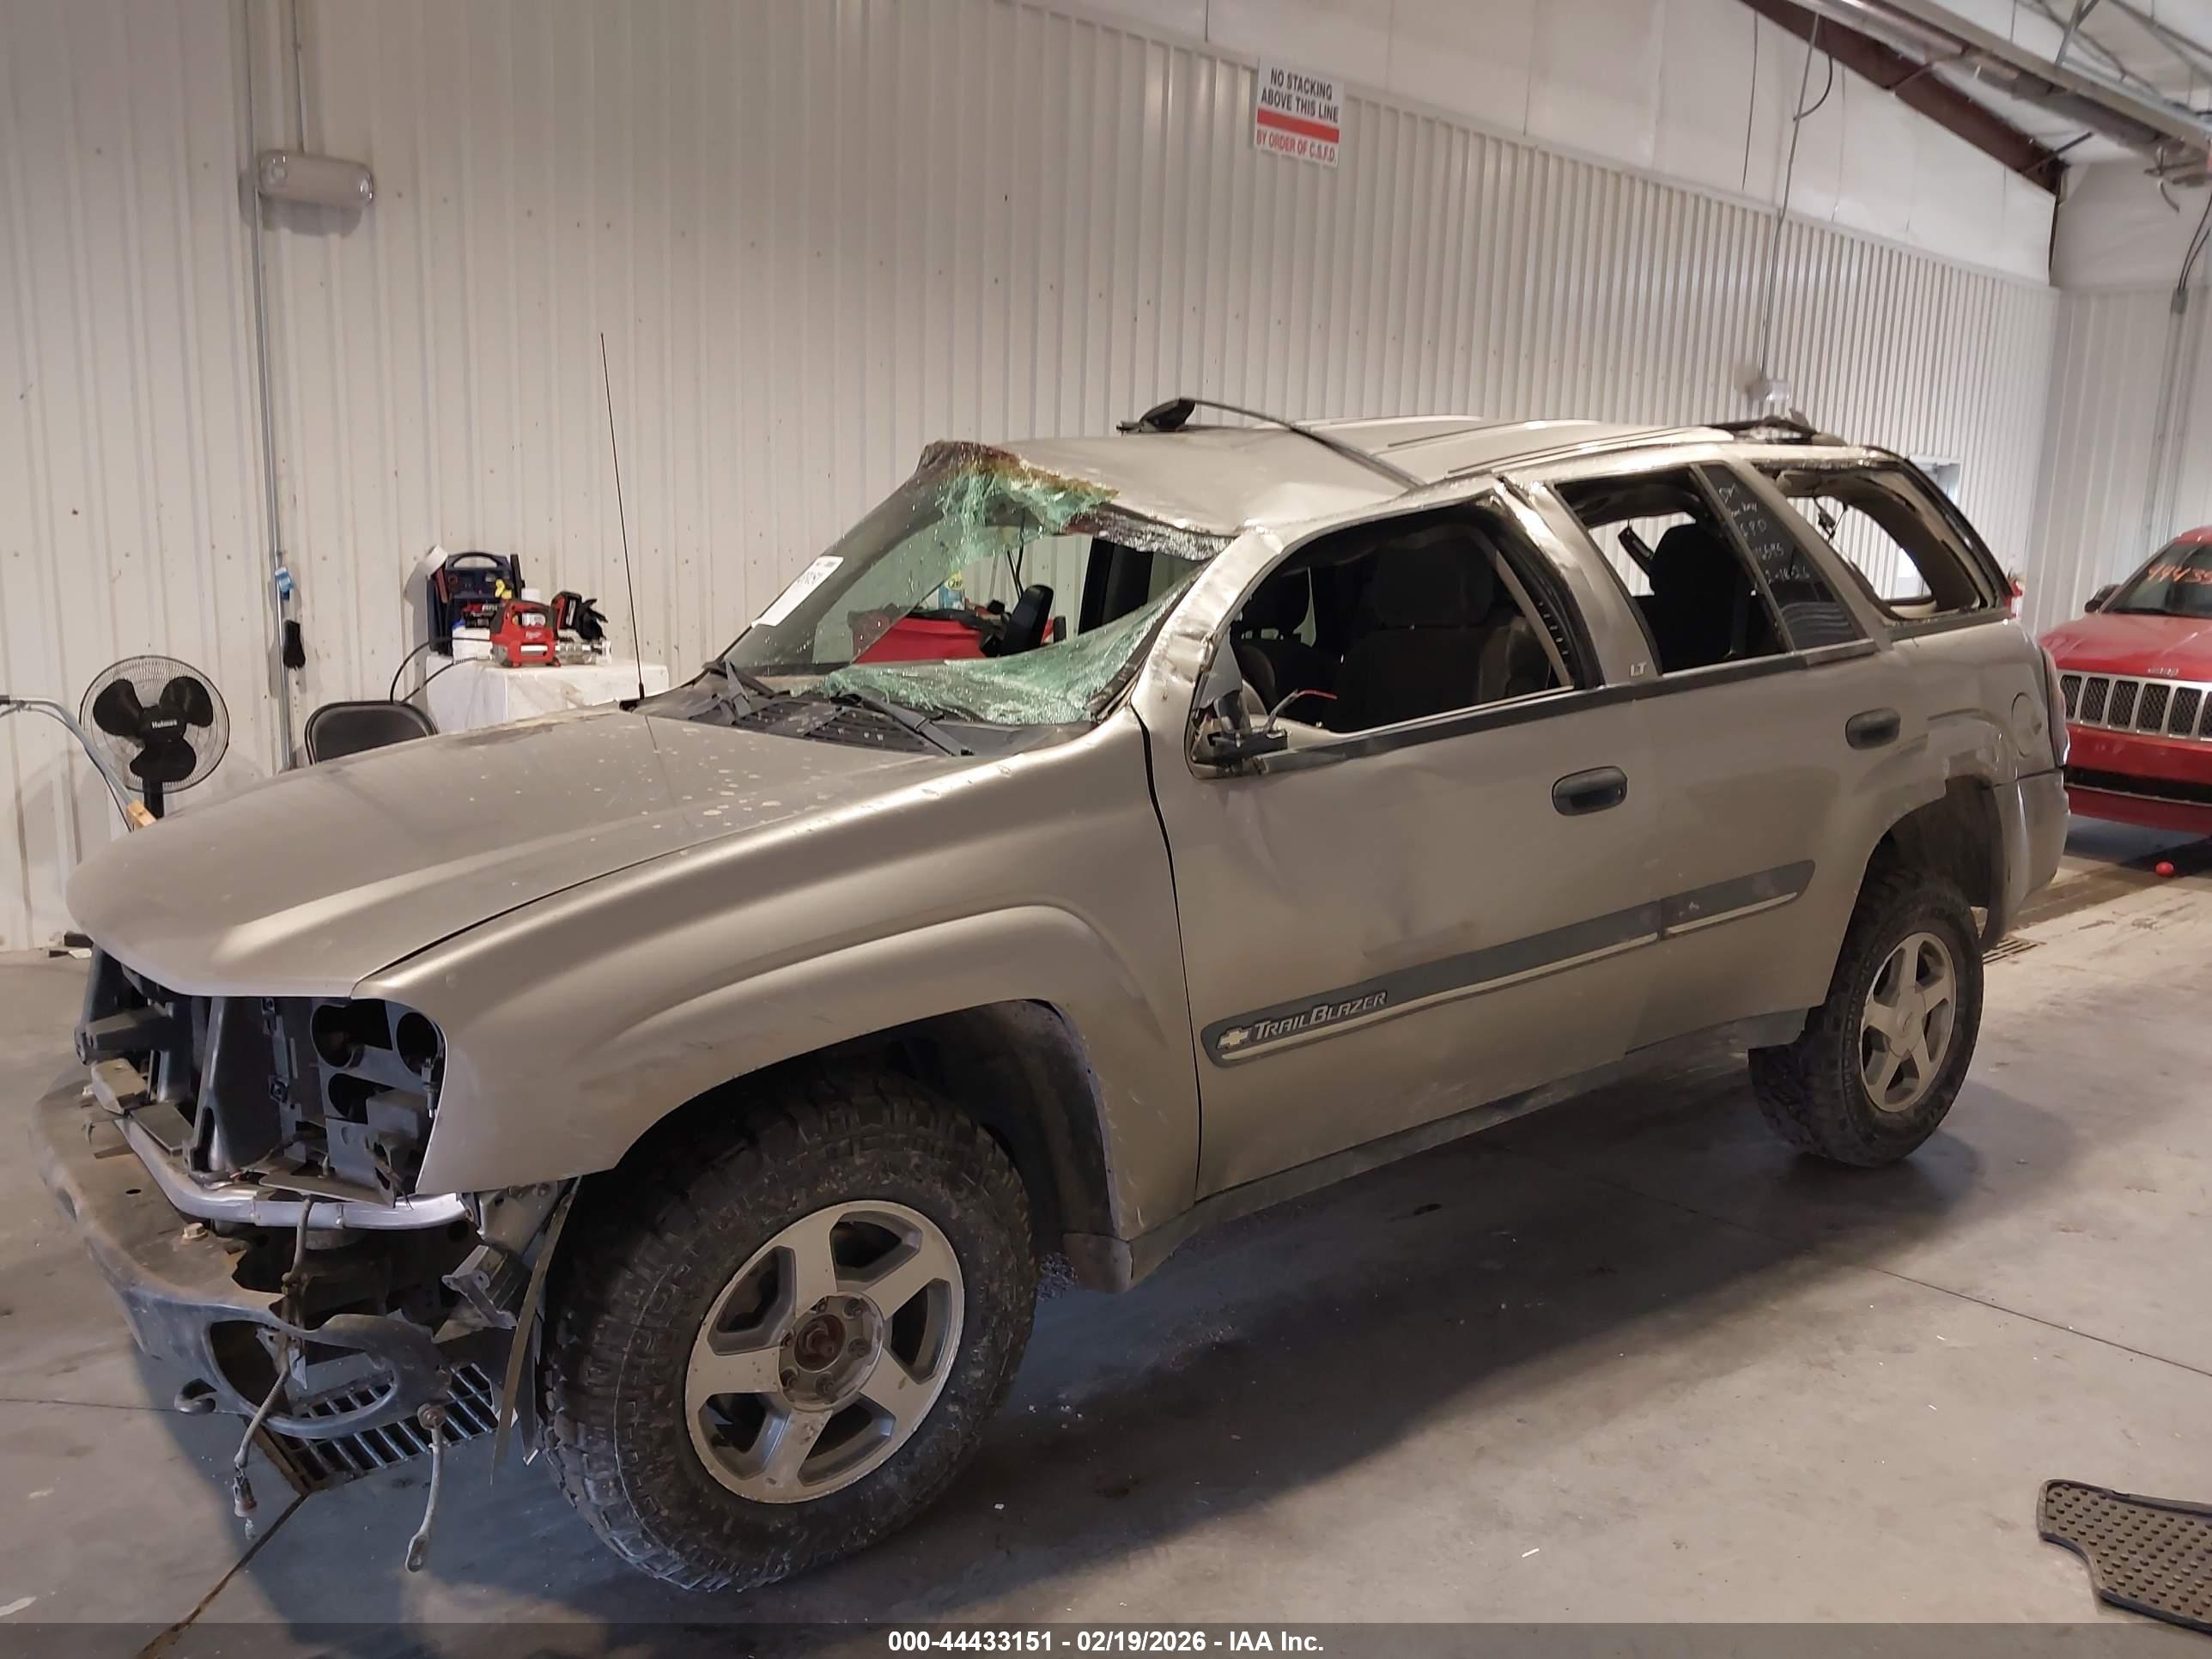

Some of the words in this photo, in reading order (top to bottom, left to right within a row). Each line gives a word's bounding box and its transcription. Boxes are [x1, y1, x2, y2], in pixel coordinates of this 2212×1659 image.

[1271, 68, 1285, 88] NO
[1287, 73, 1333, 101] STACKING
[1261, 87, 1292, 111] ABOVE
[1296, 96, 1316, 117] THIS
[1318, 102, 1340, 124] LINE
[1256, 130, 1267, 145] BY
[1268, 133, 1296, 153] ORDER
[1297, 138, 1307, 155] OF
[1630, 661, 1647, 677] LT
